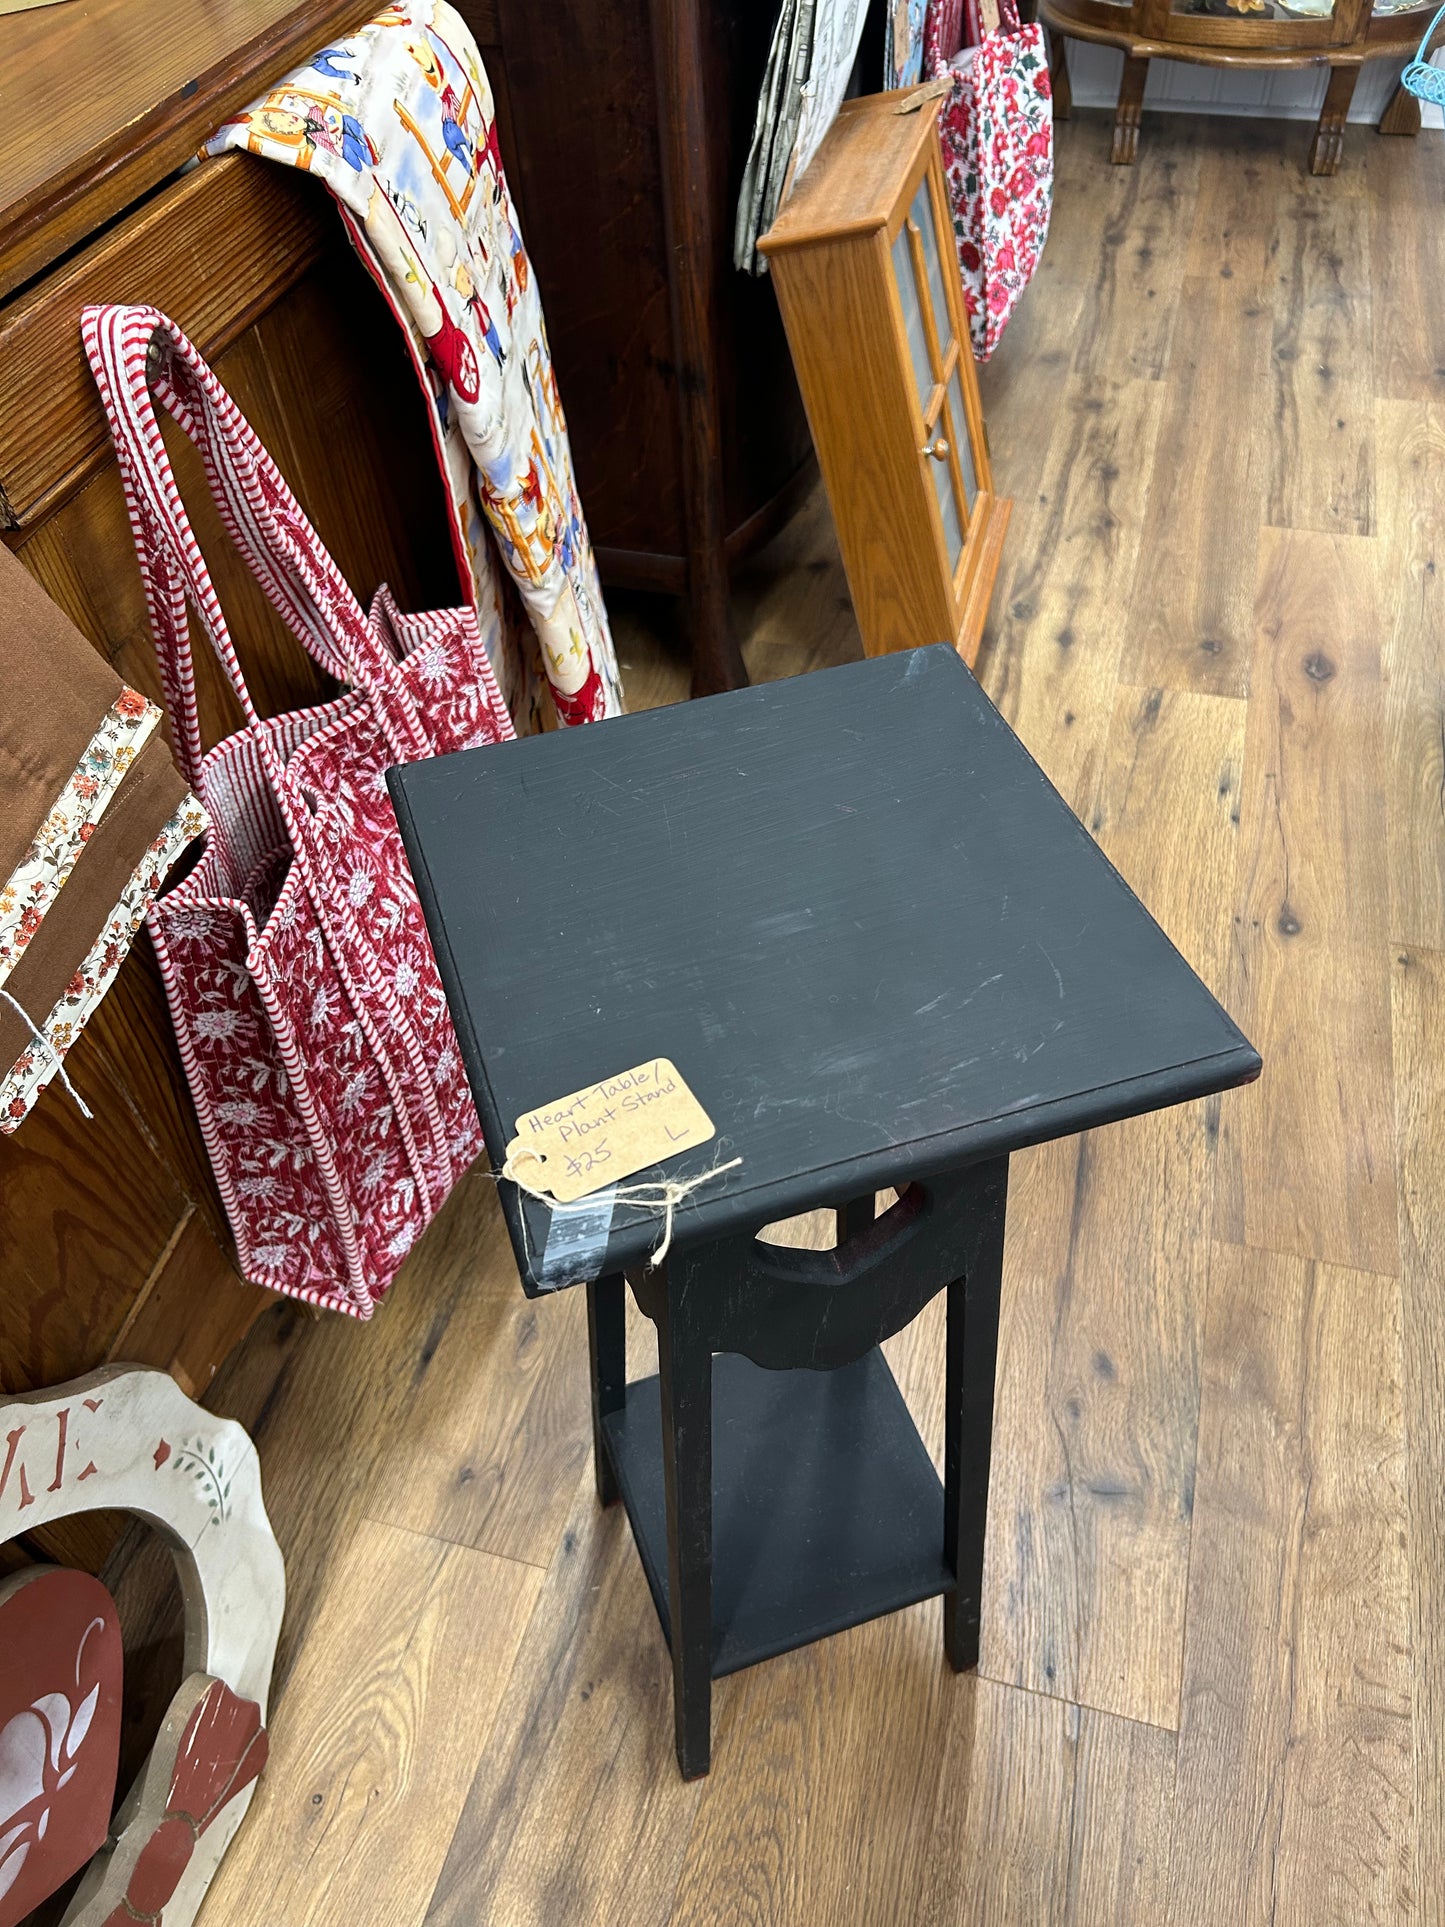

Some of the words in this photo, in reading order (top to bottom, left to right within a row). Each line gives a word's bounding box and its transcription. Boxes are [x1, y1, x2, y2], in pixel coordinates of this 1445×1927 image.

[528, 1095, 589, 1133] Heart
[558, 1108, 617, 1143] Plant
[621, 1077, 676, 1112] Stand
[563, 1137, 612, 1177] $25
